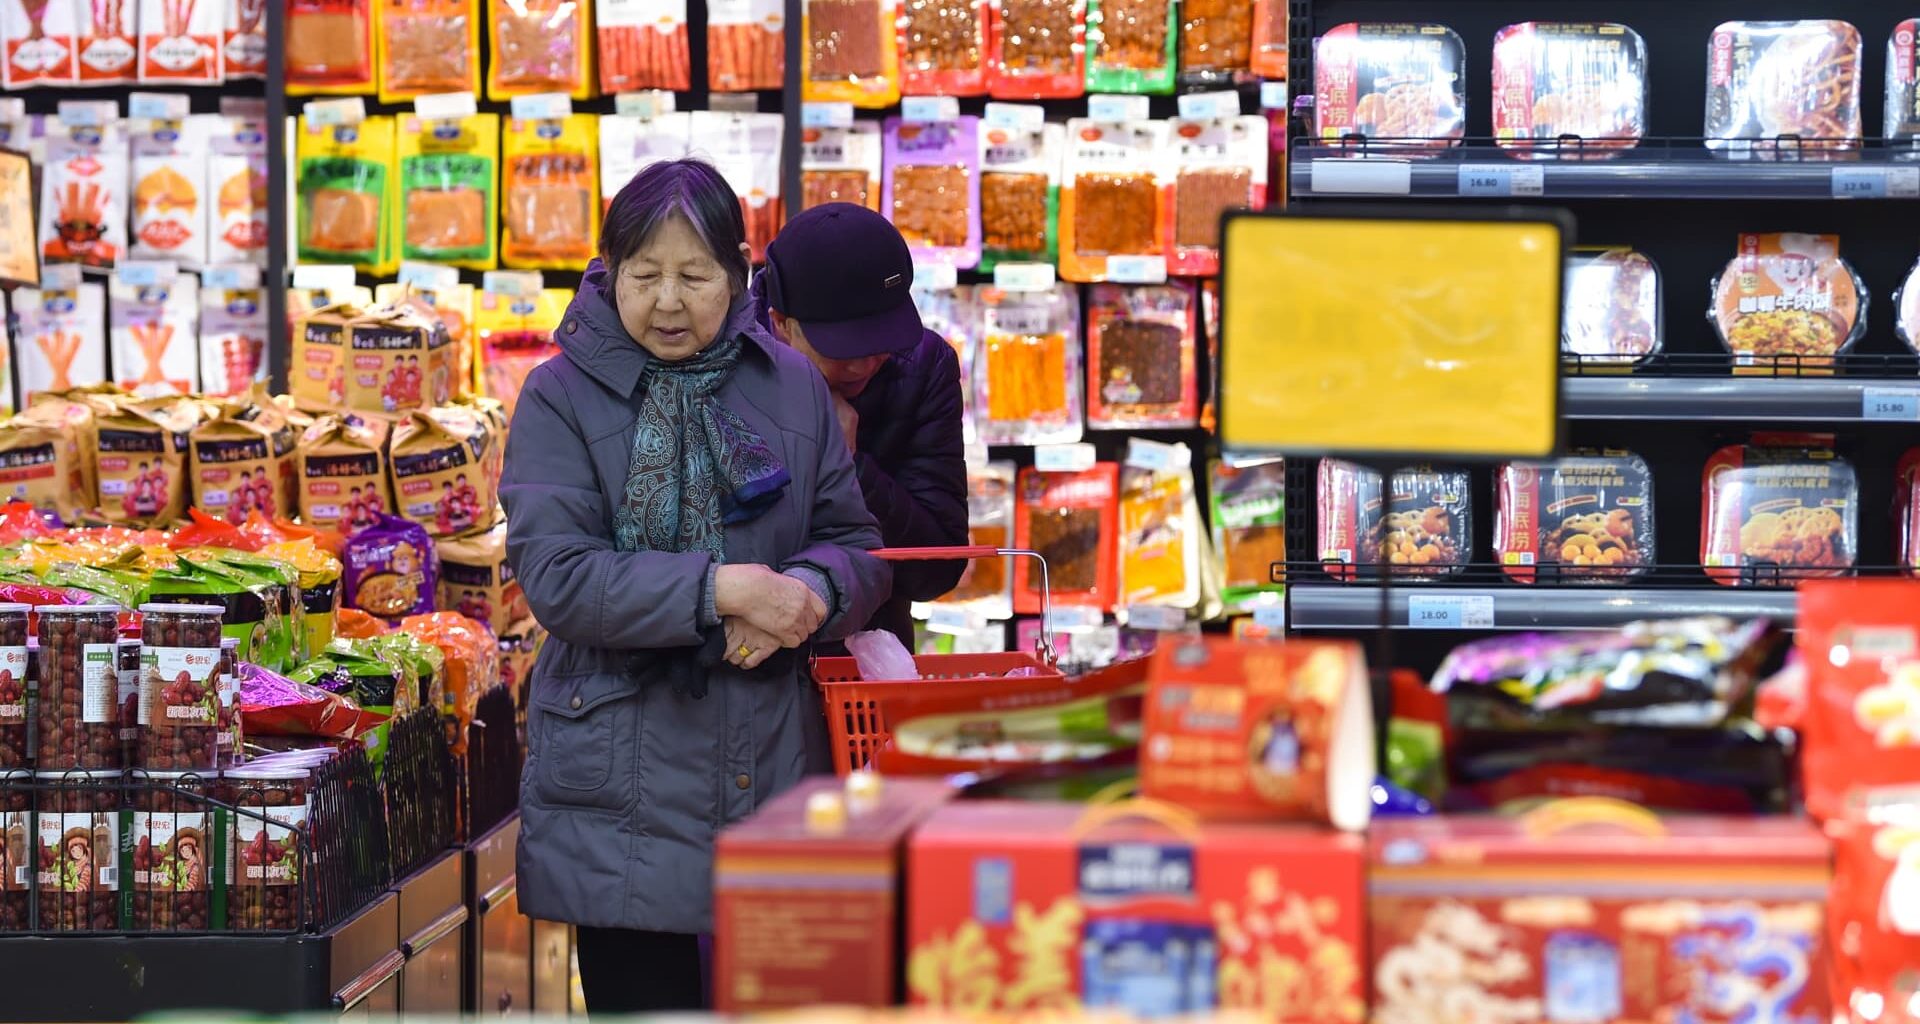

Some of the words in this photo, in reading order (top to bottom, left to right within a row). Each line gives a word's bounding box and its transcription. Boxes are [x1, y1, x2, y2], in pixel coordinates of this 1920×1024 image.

[1470, 179, 1498, 188] 16.80
[1843, 182, 1872, 191] 12.50
[1876, 403, 1905, 413] 15.80
[1421, 611, 1449, 620] 18.00
